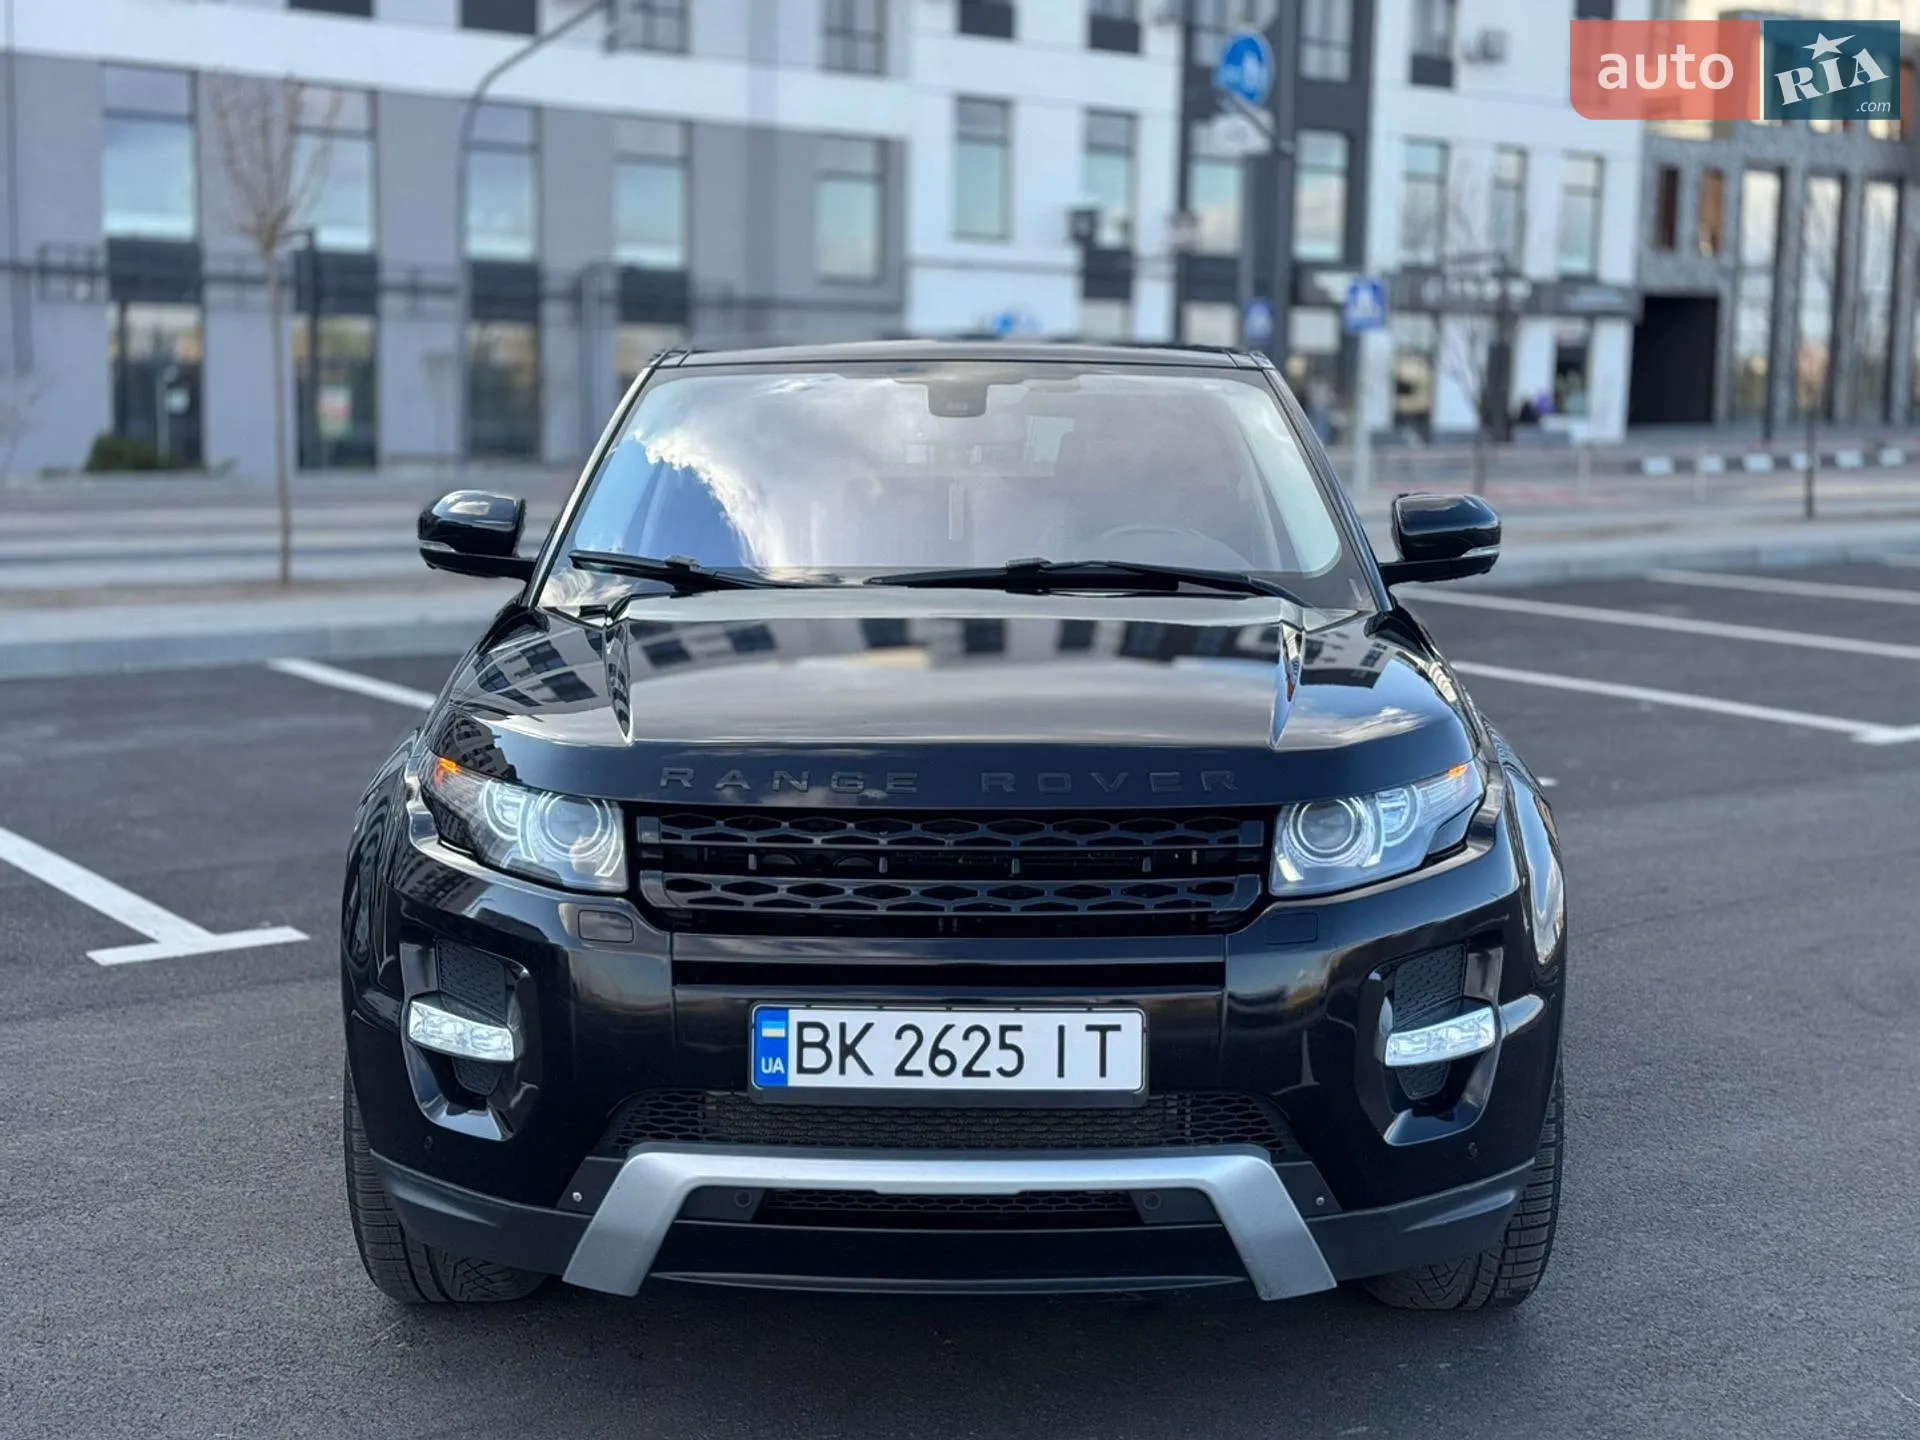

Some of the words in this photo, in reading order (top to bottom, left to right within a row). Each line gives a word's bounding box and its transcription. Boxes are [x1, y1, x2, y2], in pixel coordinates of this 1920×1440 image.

[659, 766, 919, 794] RANGE
[980, 770, 1238, 793] ROVER
[795, 1021, 875, 1076] BK
[894, 1023, 1025, 1078] 2625
[760, 1056, 786, 1074] UA
